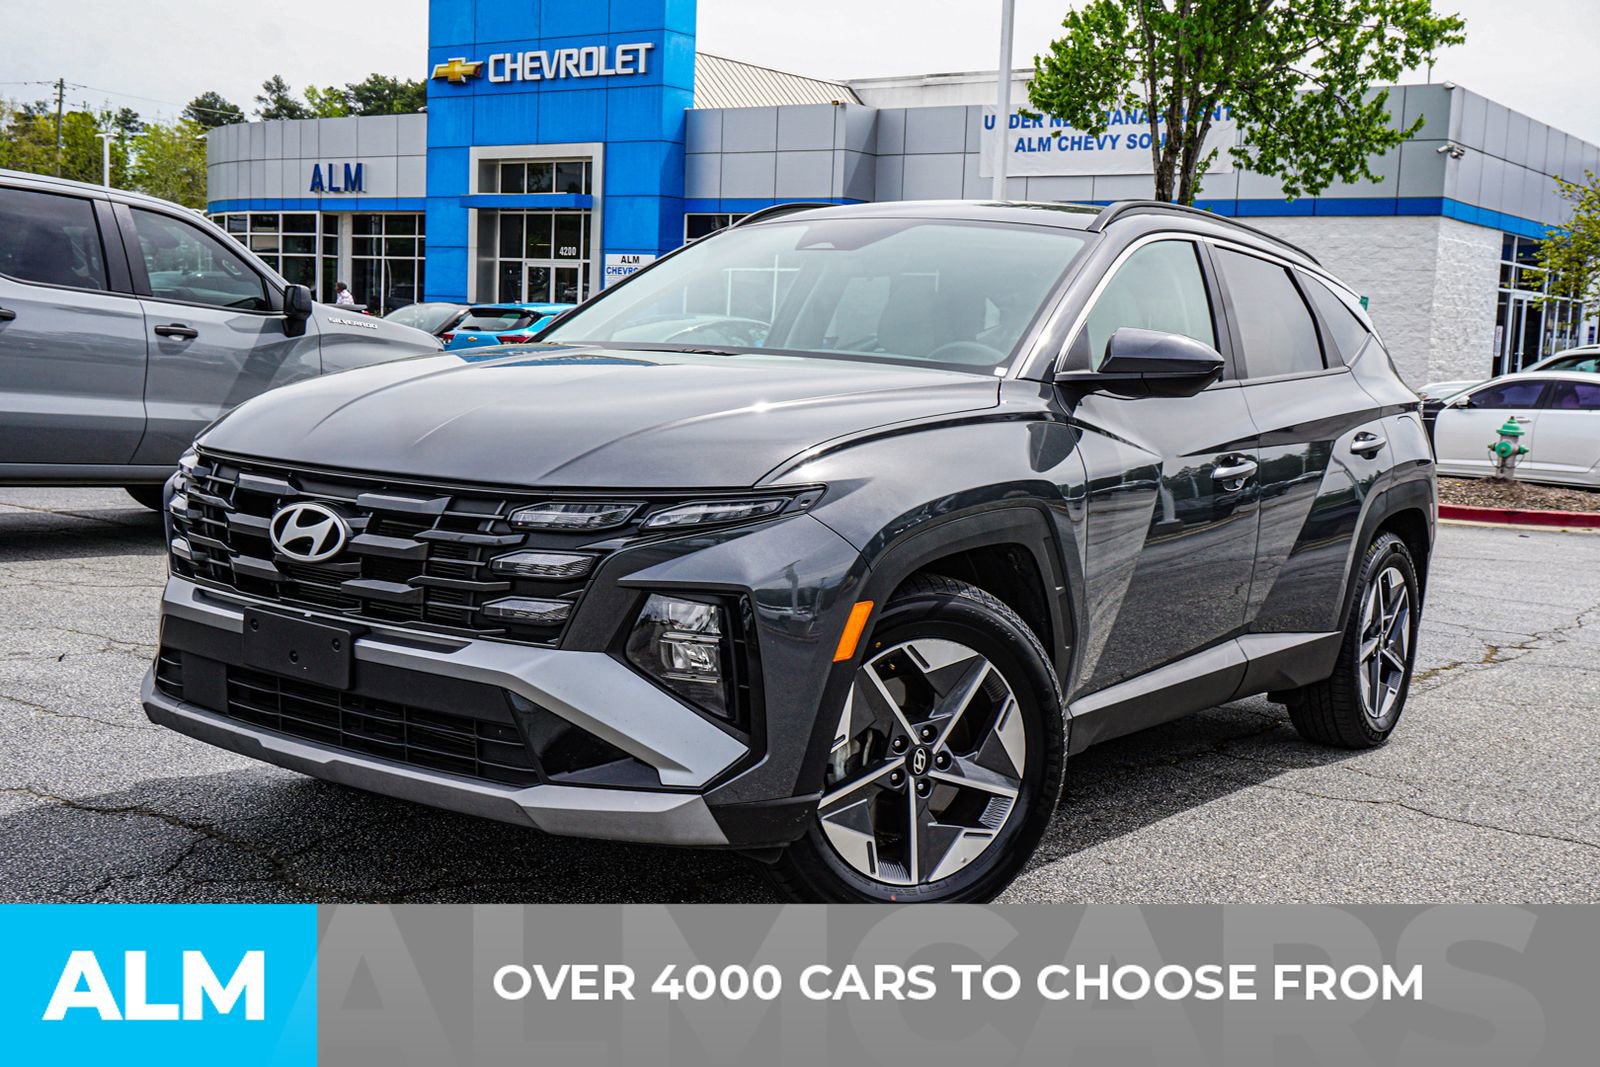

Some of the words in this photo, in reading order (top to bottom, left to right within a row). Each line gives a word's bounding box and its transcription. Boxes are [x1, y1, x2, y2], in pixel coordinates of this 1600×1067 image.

[488, 42, 654, 83] CHEVROLET
[984, 113, 1044, 130] UDER
[1014, 136, 1051, 153] ALM
[1057, 133, 1121, 151] CHEVY
[310, 162, 363, 193] ALM
[559, 246, 577, 256] 4200
[621, 255, 640, 264] ALM
